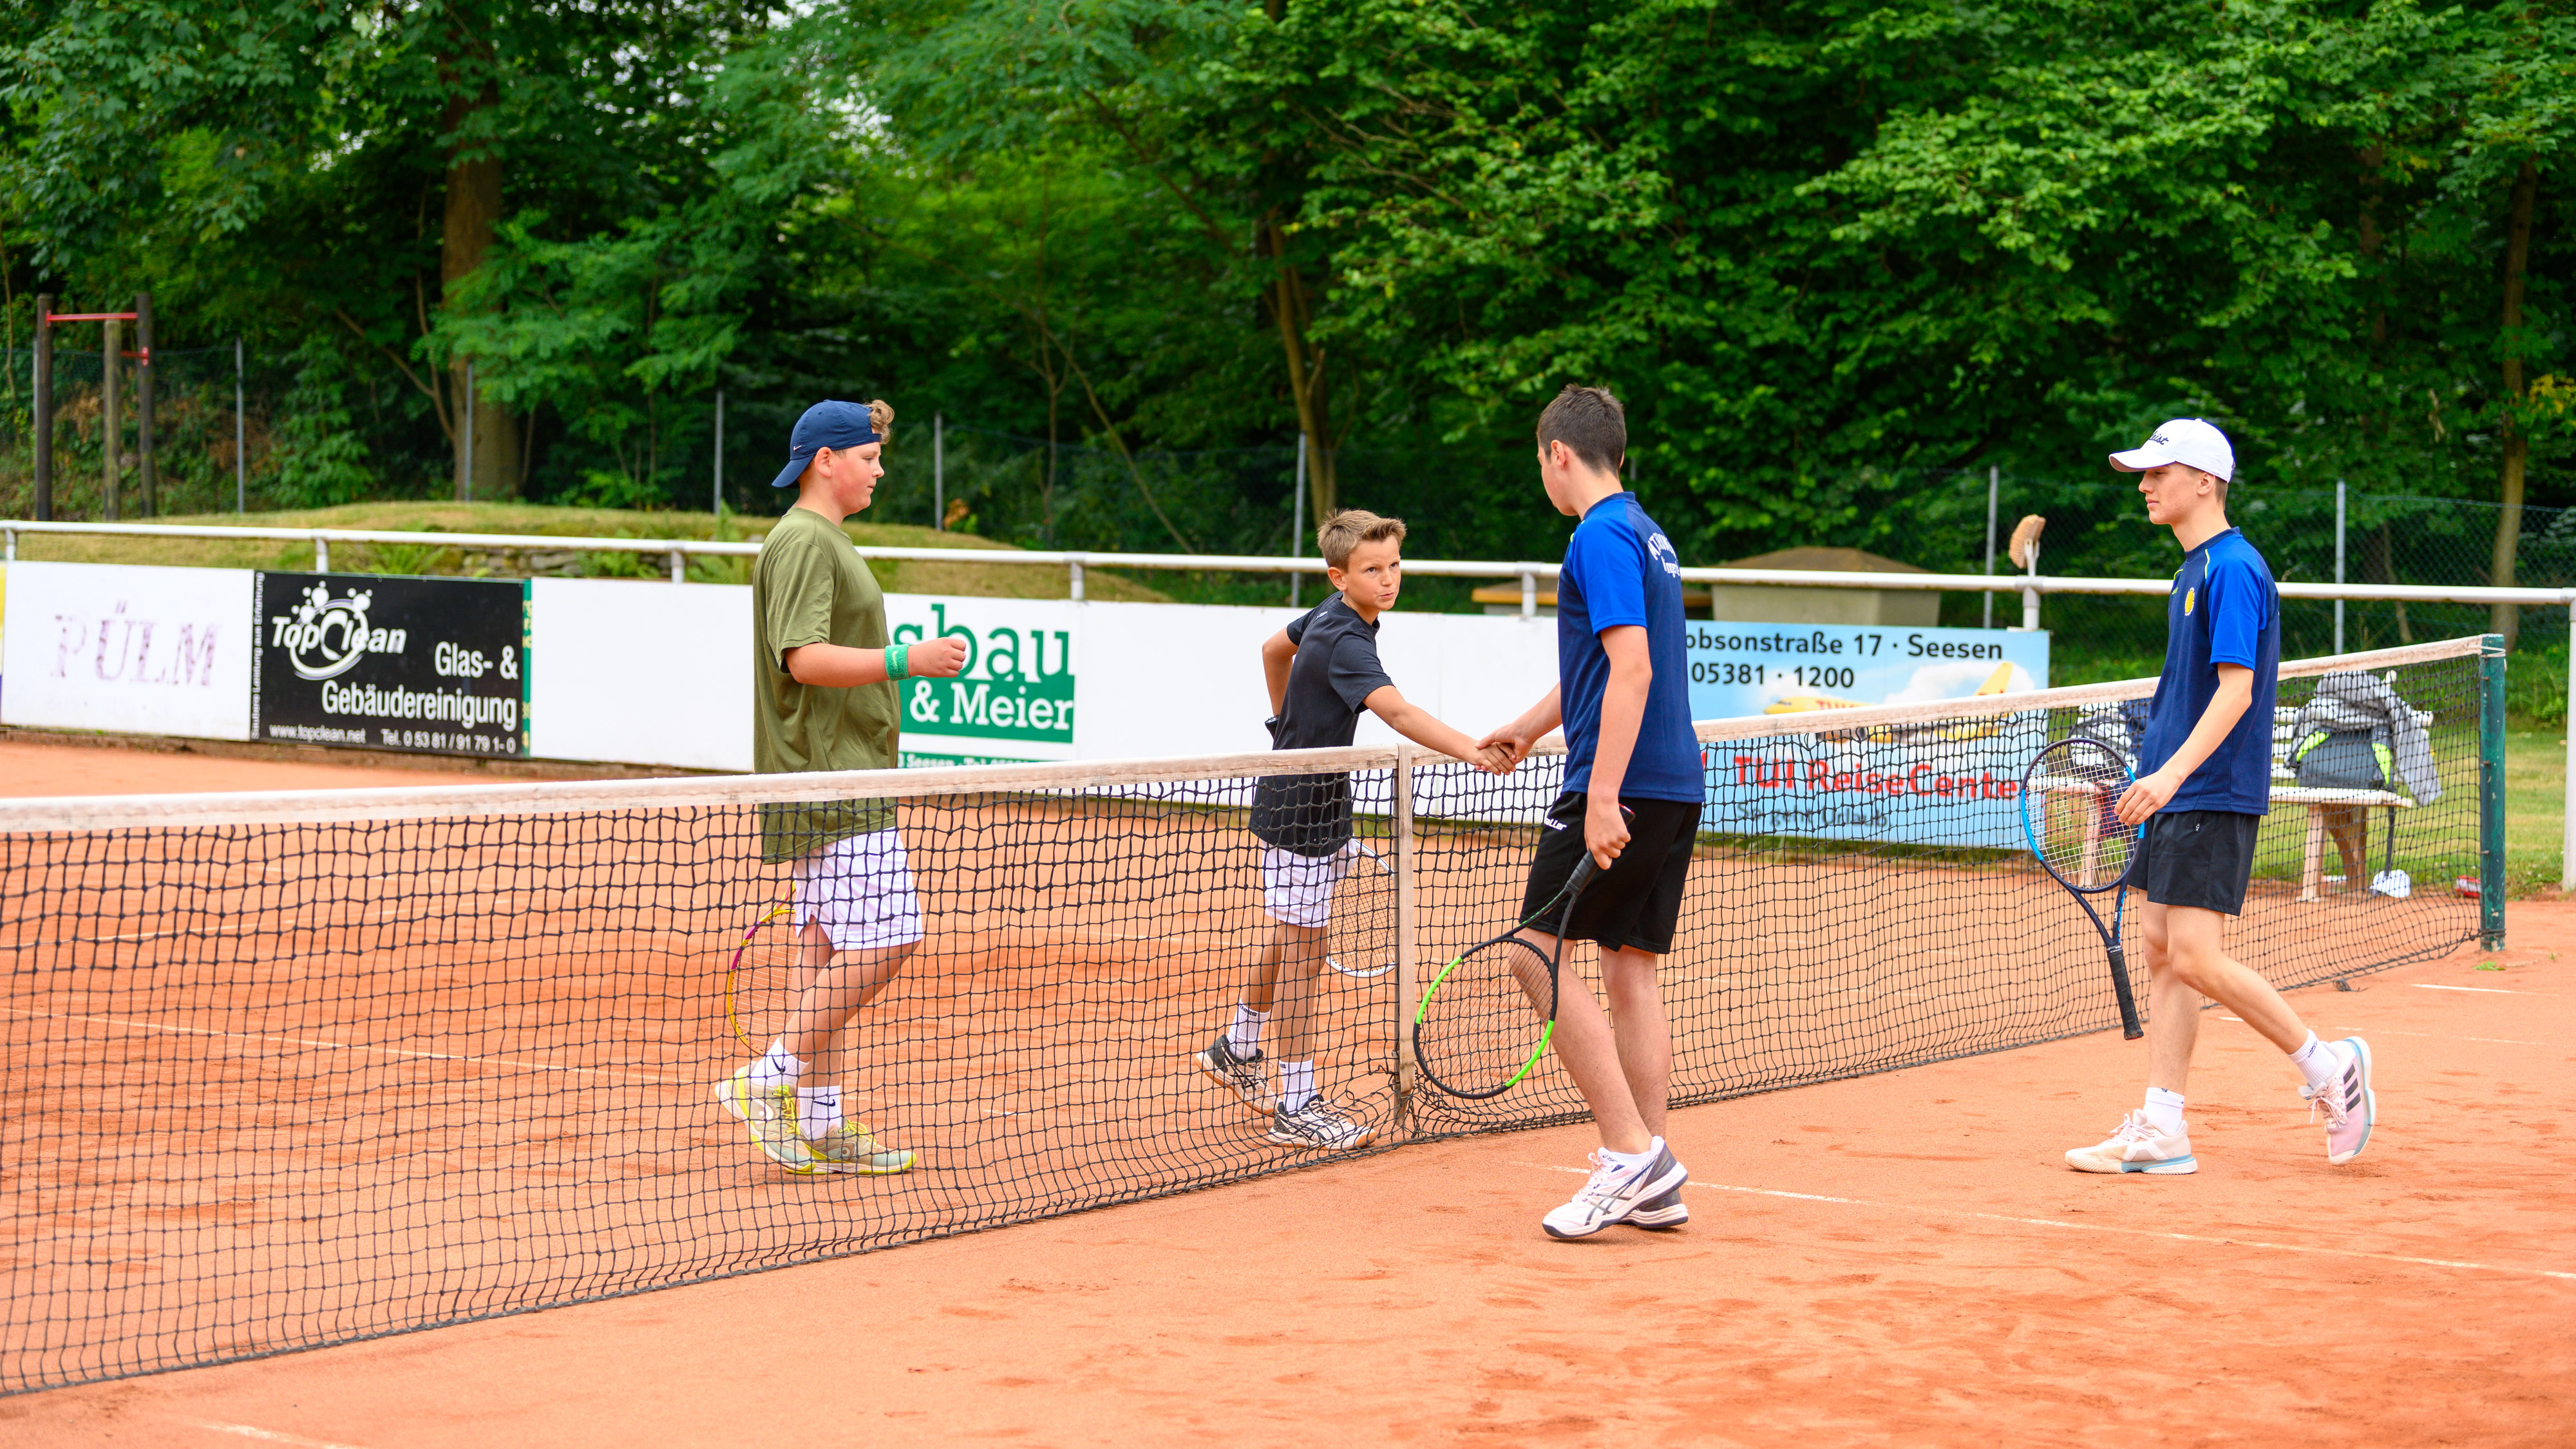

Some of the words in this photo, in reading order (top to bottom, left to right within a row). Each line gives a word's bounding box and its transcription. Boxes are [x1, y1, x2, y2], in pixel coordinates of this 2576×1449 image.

[50, 600, 221, 687] PÜLM
[435, 641, 494, 679] Glas-
[499, 645, 519, 680] &
[1854, 634, 1882, 656] 17
[1908, 634, 2003, 659] Seesen
[1692, 662, 1765, 685] 05381
[1794, 666, 1855, 688] 1200
[321, 679, 517, 732] Gebäudereinigung
[909, 679, 941, 723] &
[949, 681, 1074, 731] Meier
[269, 723, 366, 744] www.topclean.net
[380, 728, 402, 746] Tel.
[1733, 755, 1795, 790] TUI
[1808, 758, 2020, 801] ReiseCente
